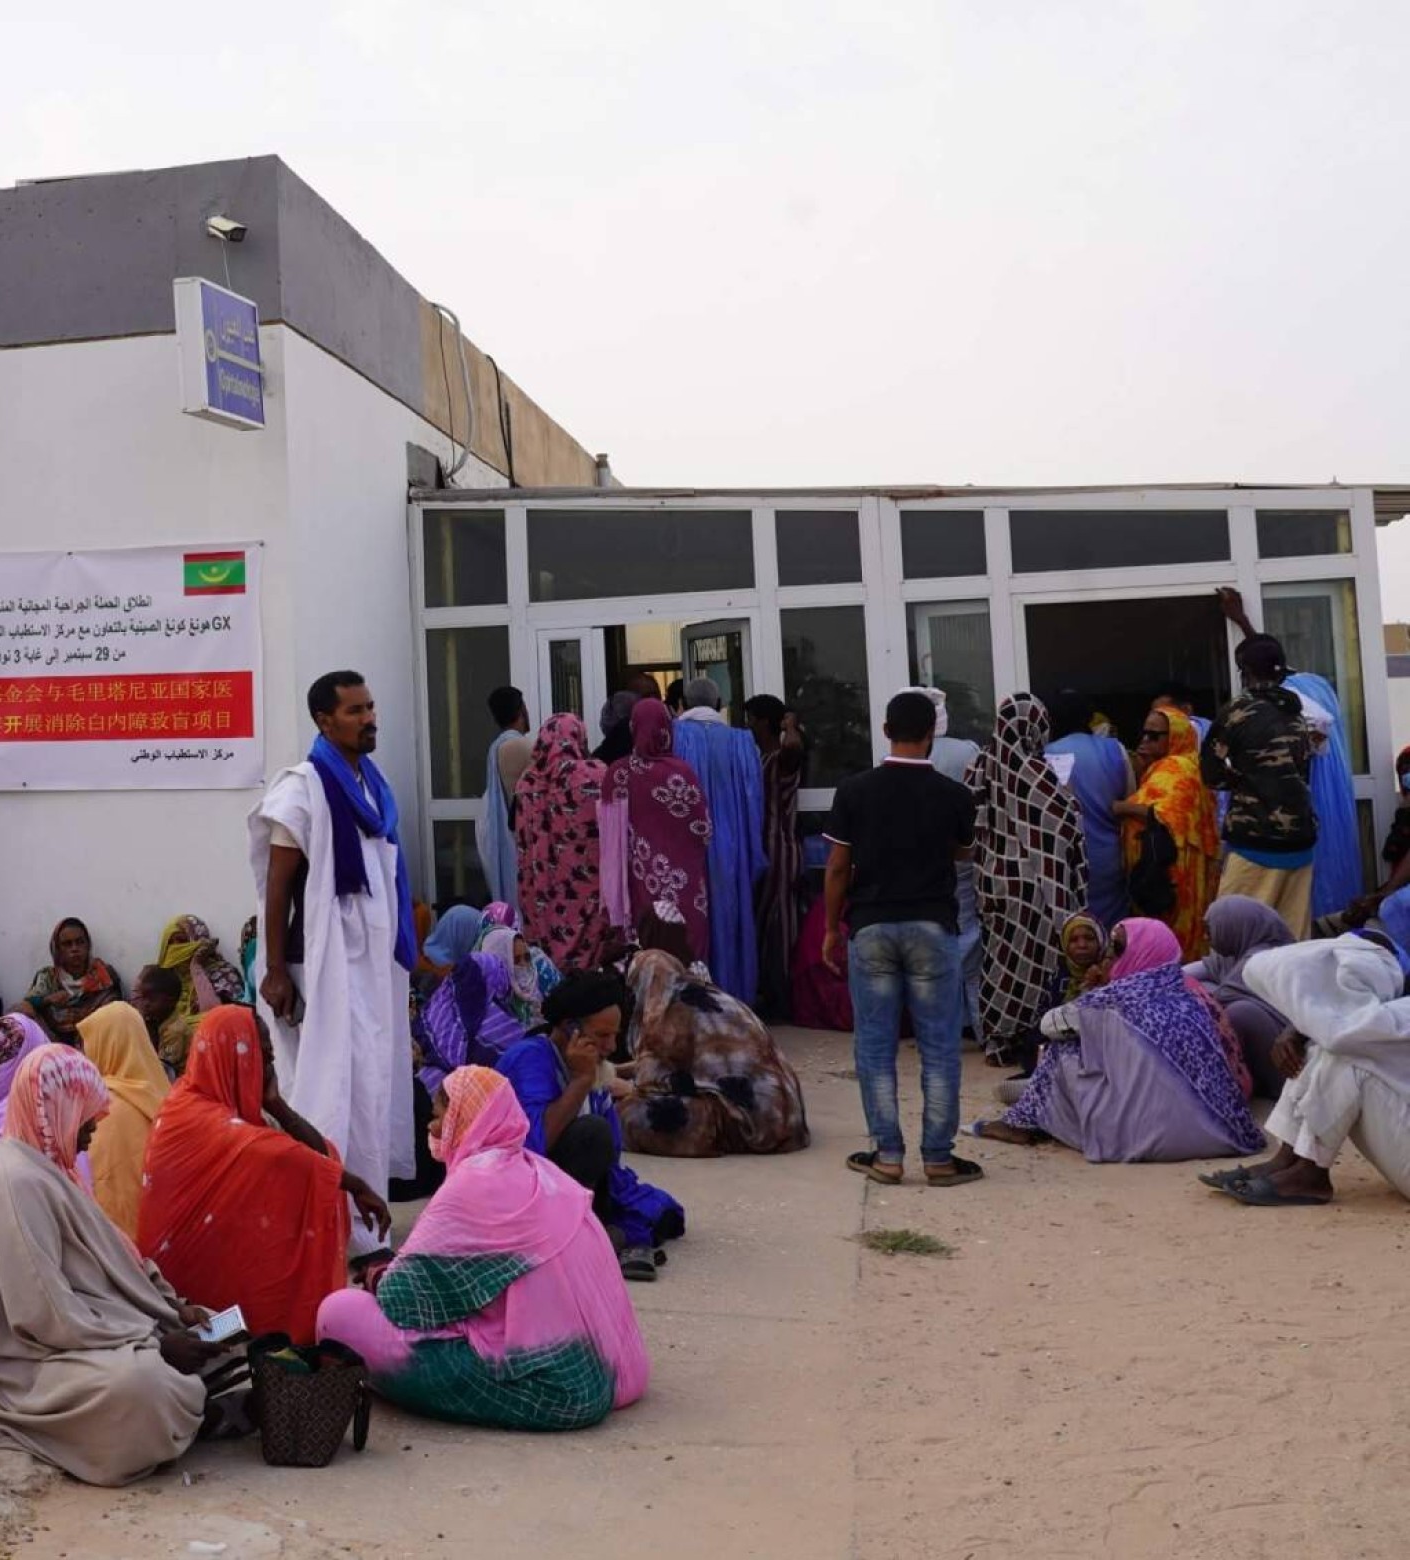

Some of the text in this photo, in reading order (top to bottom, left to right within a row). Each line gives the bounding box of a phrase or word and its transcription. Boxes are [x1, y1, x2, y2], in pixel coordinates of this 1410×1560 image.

[94, 594, 120, 610] الحملة
[54, 624, 76, 639] مركز
[78, 625, 90, 640] مع
[93, 620, 127, 638] بالتعاون
[130, 617, 161, 637] الصينية
[165, 617, 186, 637] كونغ
[14, 649, 21, 664] 3
[23, 646, 42, 664] غاية
[63, 647, 92, 664] سبتمبر
[95, 646, 110, 662] 29
[112, 648, 126, 662] من
[212, 748, 234, 761] مركز
